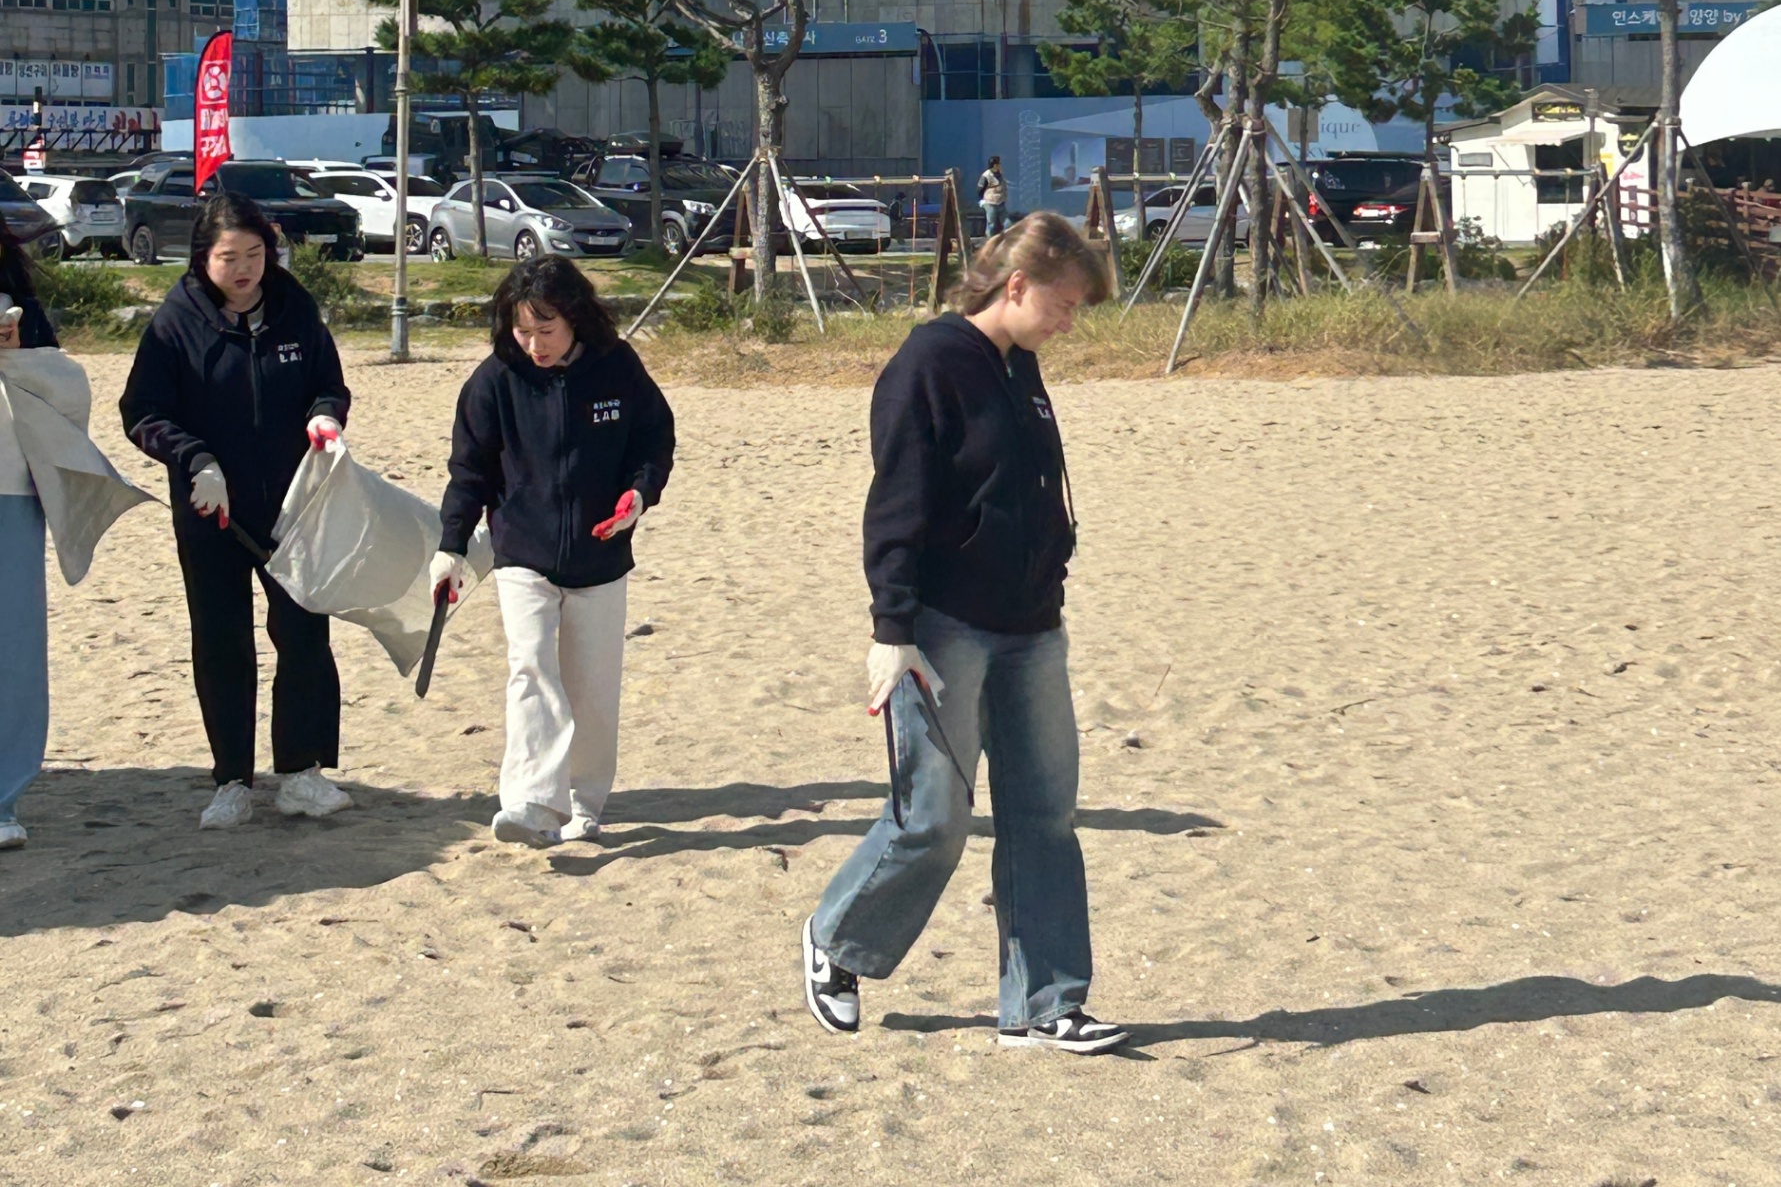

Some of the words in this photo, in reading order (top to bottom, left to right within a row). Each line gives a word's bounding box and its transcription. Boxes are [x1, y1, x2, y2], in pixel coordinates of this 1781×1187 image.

[1611, 9, 1662, 27] 인스케
[1689, 8, 1719, 26] 양양
[1723, 9, 1743, 25] by
[762, 29, 817, 47] 신축사
[878, 28, 888, 44] 3
[1320, 115, 1361, 140] ique
[593, 409, 620, 423] LAB
